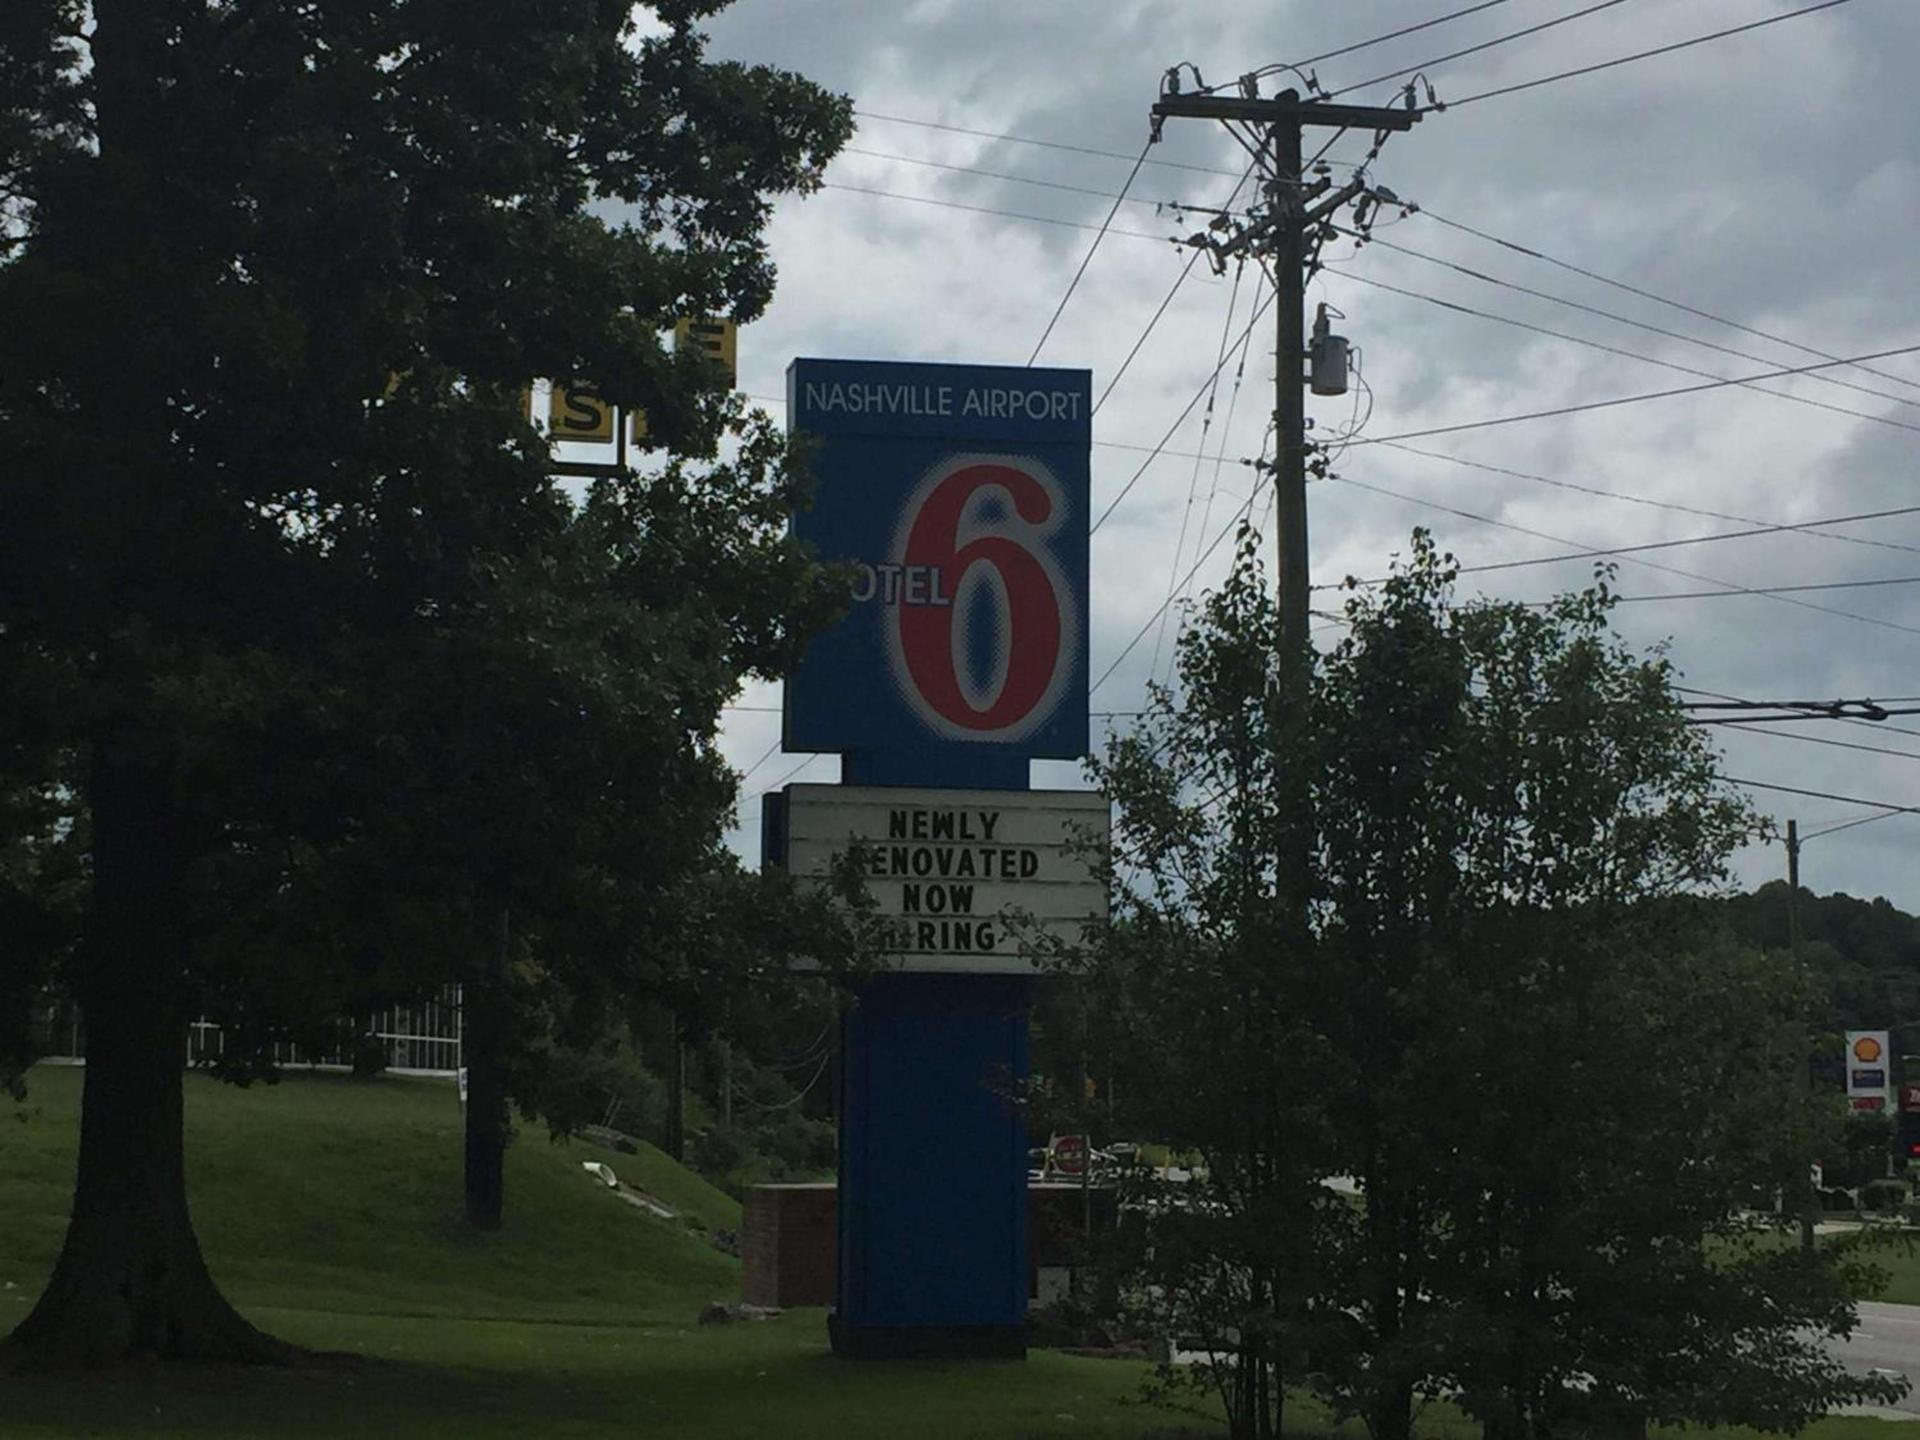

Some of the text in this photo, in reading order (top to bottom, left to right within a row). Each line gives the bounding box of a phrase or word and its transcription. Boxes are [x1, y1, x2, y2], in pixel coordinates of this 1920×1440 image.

[805, 382, 1082, 420] NASHVILLE AIRPORT
[848, 461, 1064, 734] OTEL 6
[889, 810, 999, 840] NEWLY
[871, 845, 1039, 878] ENOVATED
[903, 884, 975, 913] NOW
[883, 921, 996, 951] RING
